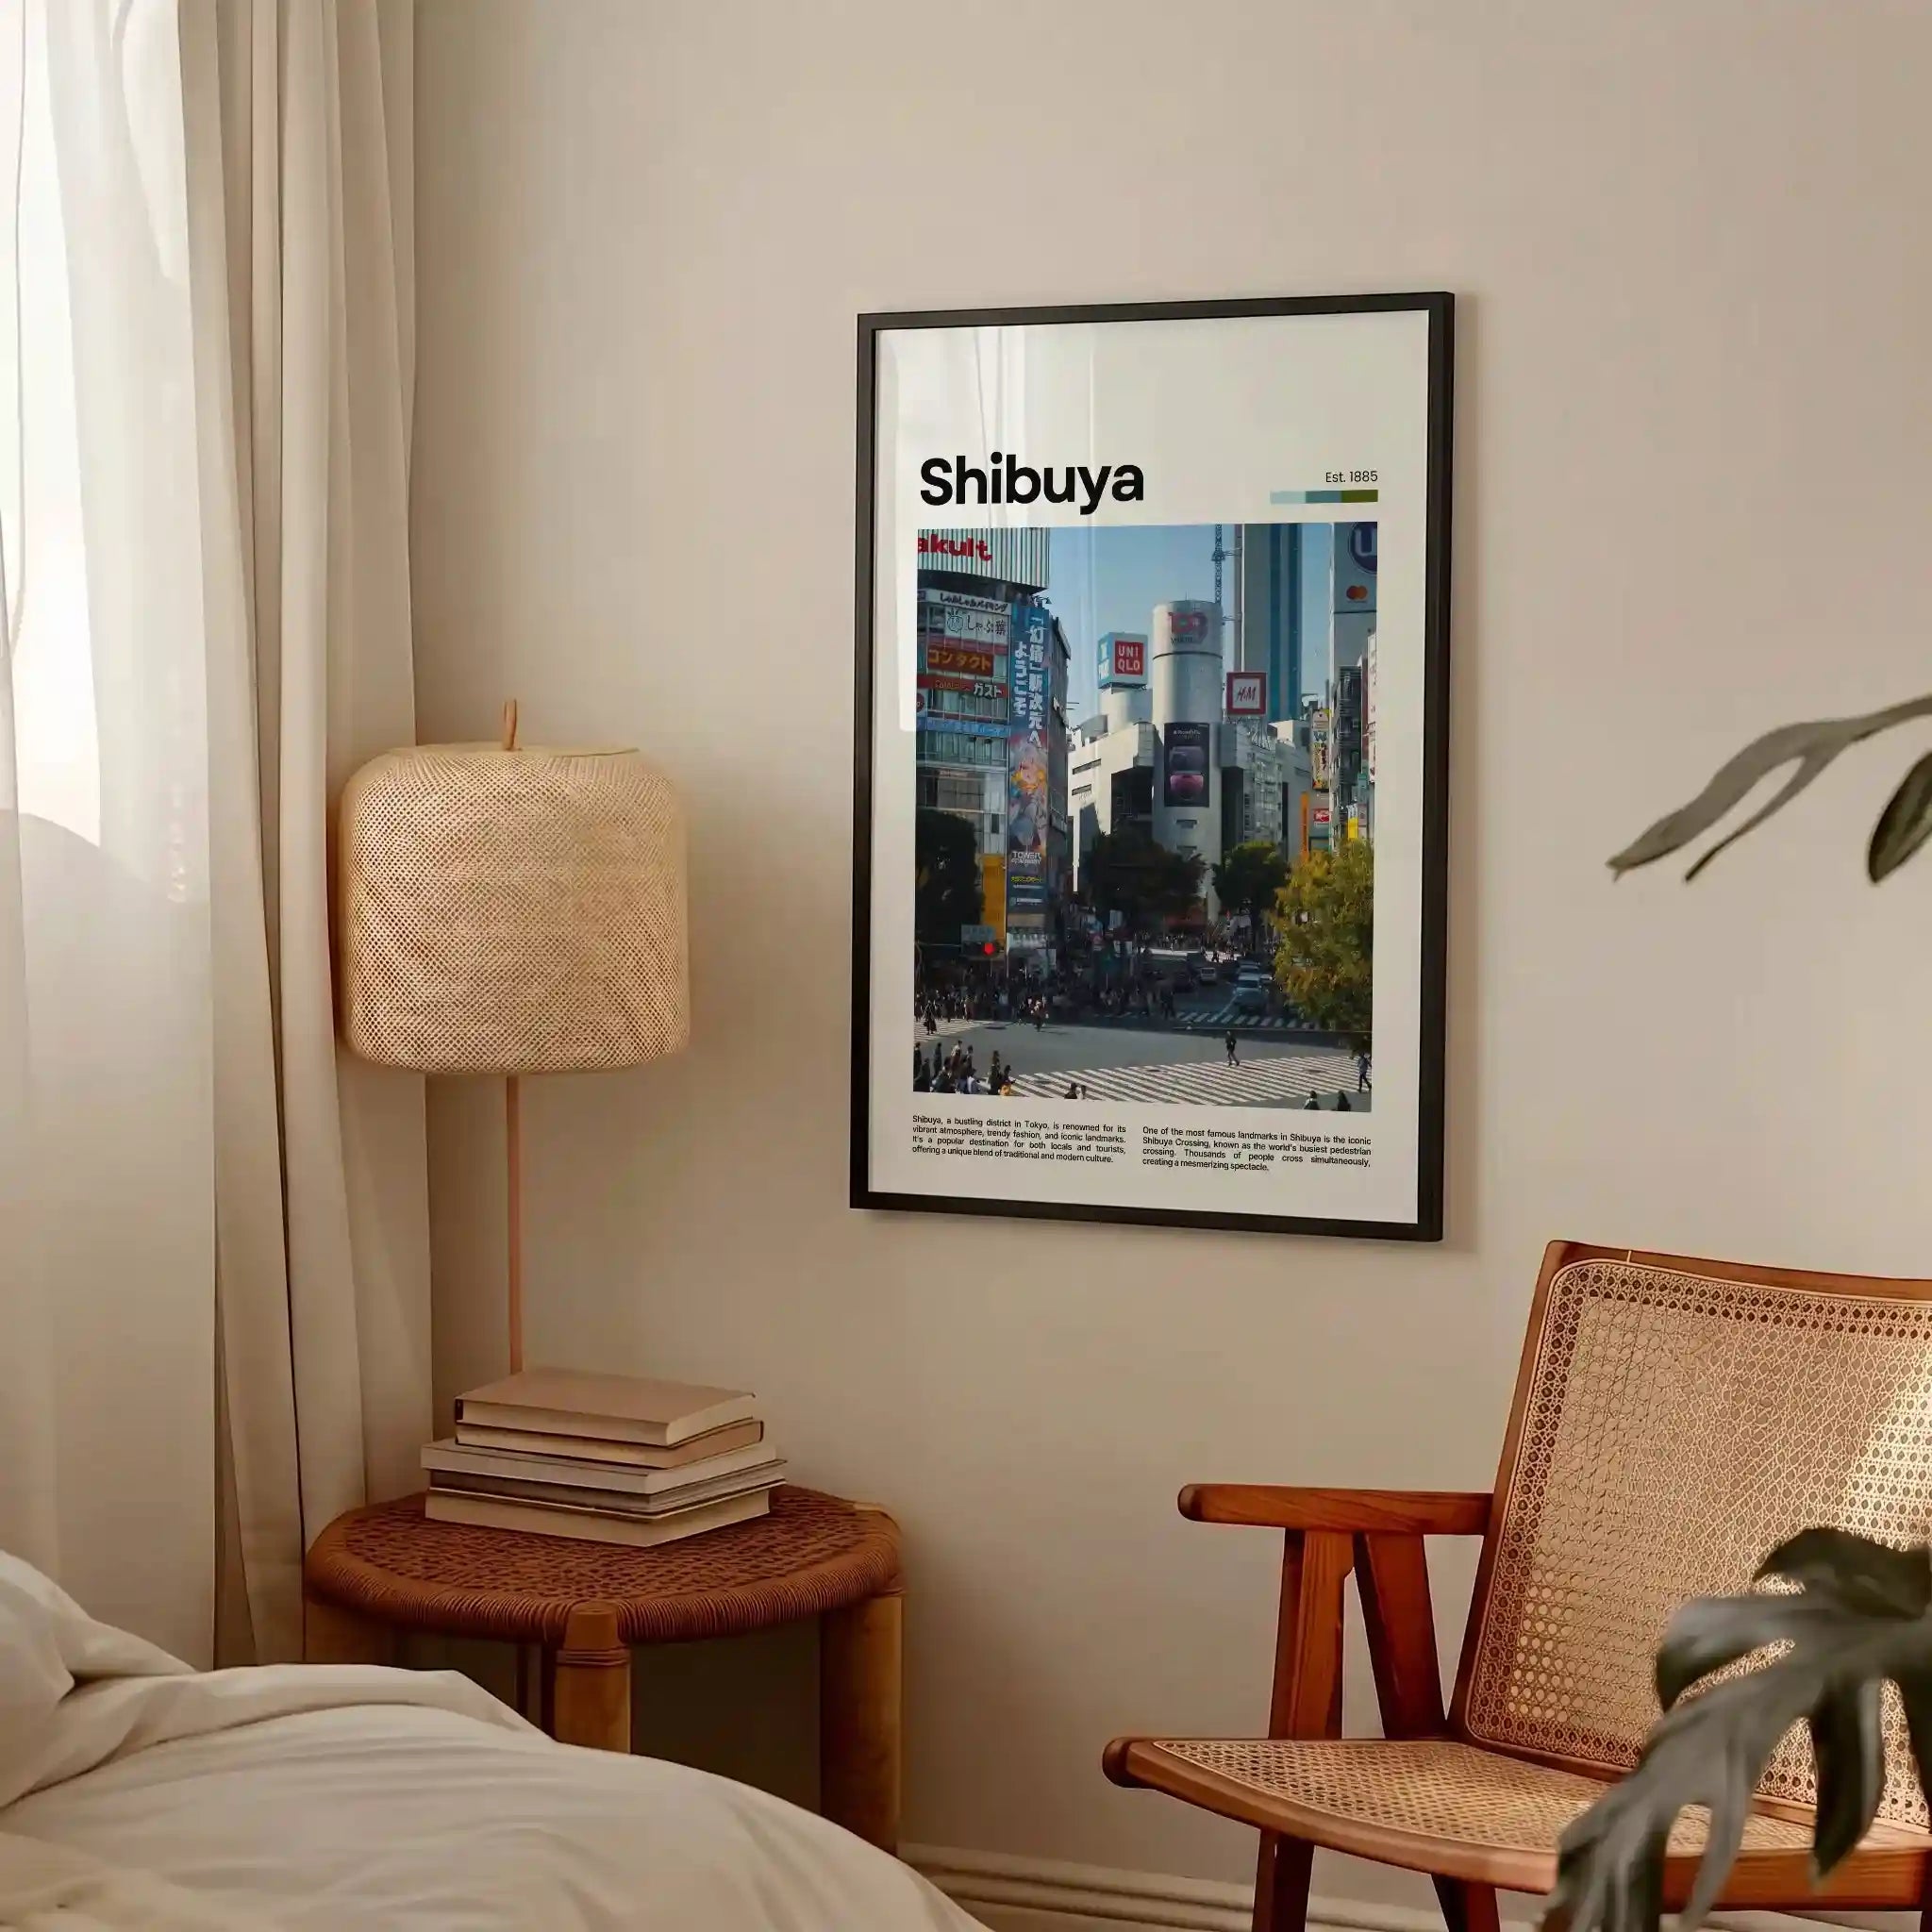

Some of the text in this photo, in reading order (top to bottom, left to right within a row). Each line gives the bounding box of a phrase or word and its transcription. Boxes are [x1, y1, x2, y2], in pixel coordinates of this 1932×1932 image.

[921, 451, 1144, 515] Shibuya
[1325, 471, 1378, 483] Est. 1885
[928, 649, 991, 671] コンタクト
[1118, 646, 1139, 658] UNI
[1118, 659, 1141, 673] QLO
[974, 682, 1003, 698] ガスト
[912, 1115, 943, 1124] Shibuya,
[954, 1117, 984, 1126] bustling
[986, 1118, 1012, 1128] district
[1024, 1121, 1050, 1130] Tokyo,
[1053, 1122, 1059, 1130] is
[912, 1125, 938, 1135] vibrant
[939, 1128, 985, 1138] atmosphere,
[986, 1129, 1011, 1139] trendy
[1012, 1130, 1042, 1140] fashion,
[1085, 1133, 1126, 1144] landmarks.
[1142, 1126, 1158, 1135] One
[1207, 1129, 1237, 1138] famous
[1238, 1131, 1278, 1140] landmarks
[1290, 1133, 1322, 1143] Shibuya
[911, 1145, 942, 1155] offering
[947, 1147, 973, 1157] unique
[973, 1148, 994, 1157] blend
[993, 1149, 1004, 1158] of
[936, 1137, 965, 1147] popular
[969, 1139, 1009, 1147] destination
[1095, 1145, 1126, 1155] tourists,
[1142, 1137, 1174, 1146] Shibuya
[1174, 1139, 1211, 1148] Crossing,
[1299, 1144, 1328, 1153] busiest
[1329, 1146, 1374, 1157] pedestrian
[1141, 1147, 1177, 1158] crossing.
[1183, 1149, 1226, 1158] Thousands
[1248, 1154, 1275, 1162] people
[1310, 1156, 1371, 1167] simultaneously,
[1141, 1158, 1174, 1167] creating
[1179, 1158, 1229, 1170] mesmerizing
